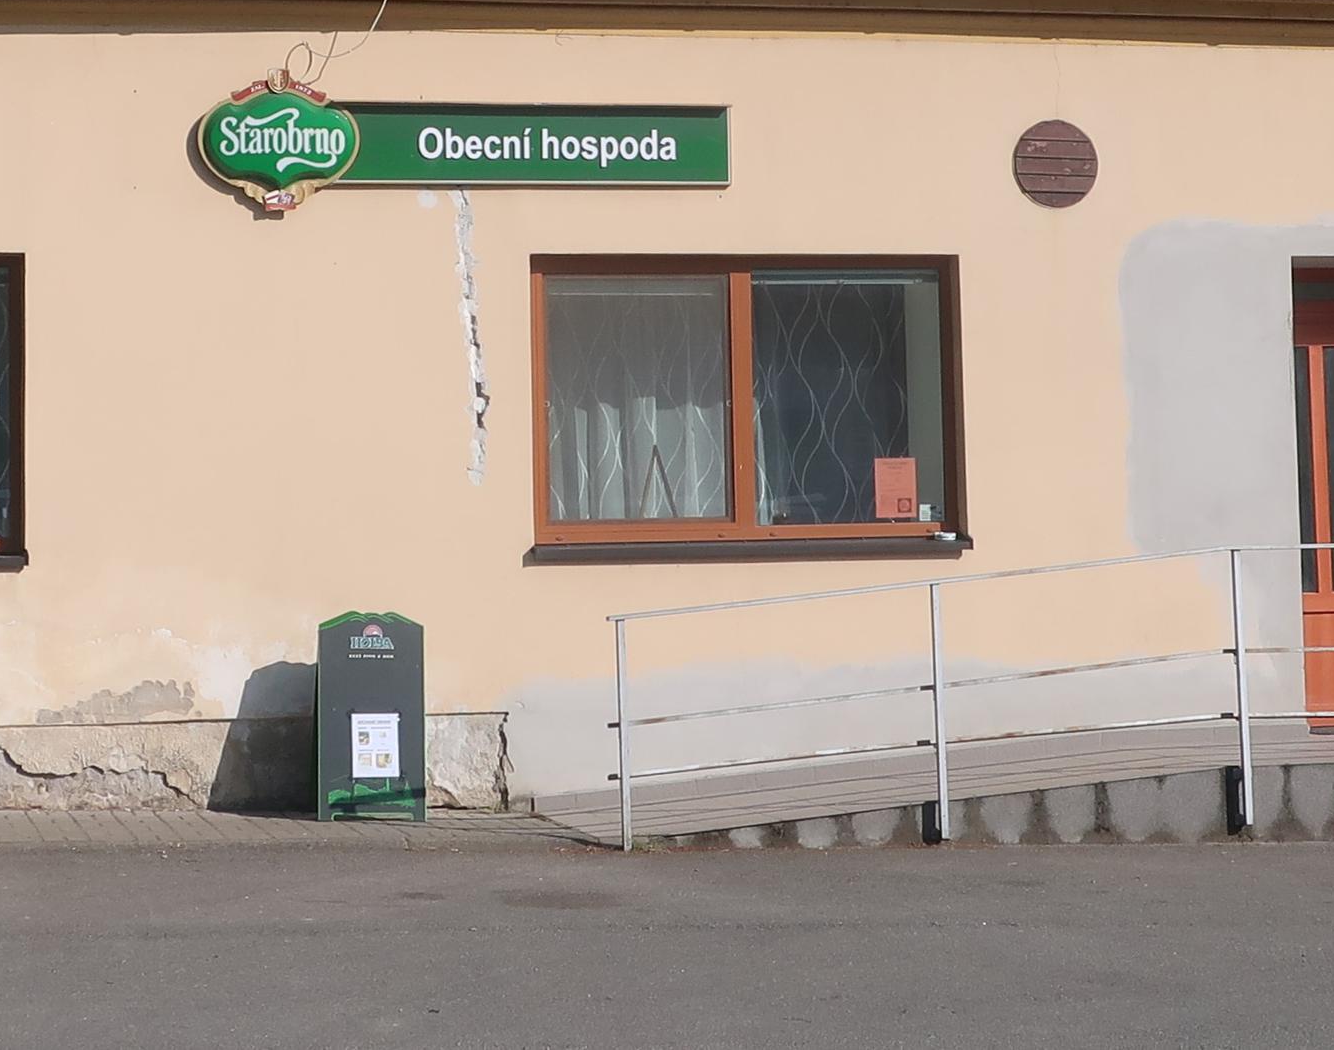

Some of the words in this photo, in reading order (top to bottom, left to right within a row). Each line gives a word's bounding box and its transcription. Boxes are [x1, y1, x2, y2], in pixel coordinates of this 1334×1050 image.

[220, 108, 346, 173] Starobrno
[418, 127, 532, 160] Obecní
[541, 128, 677, 168] hospoda
